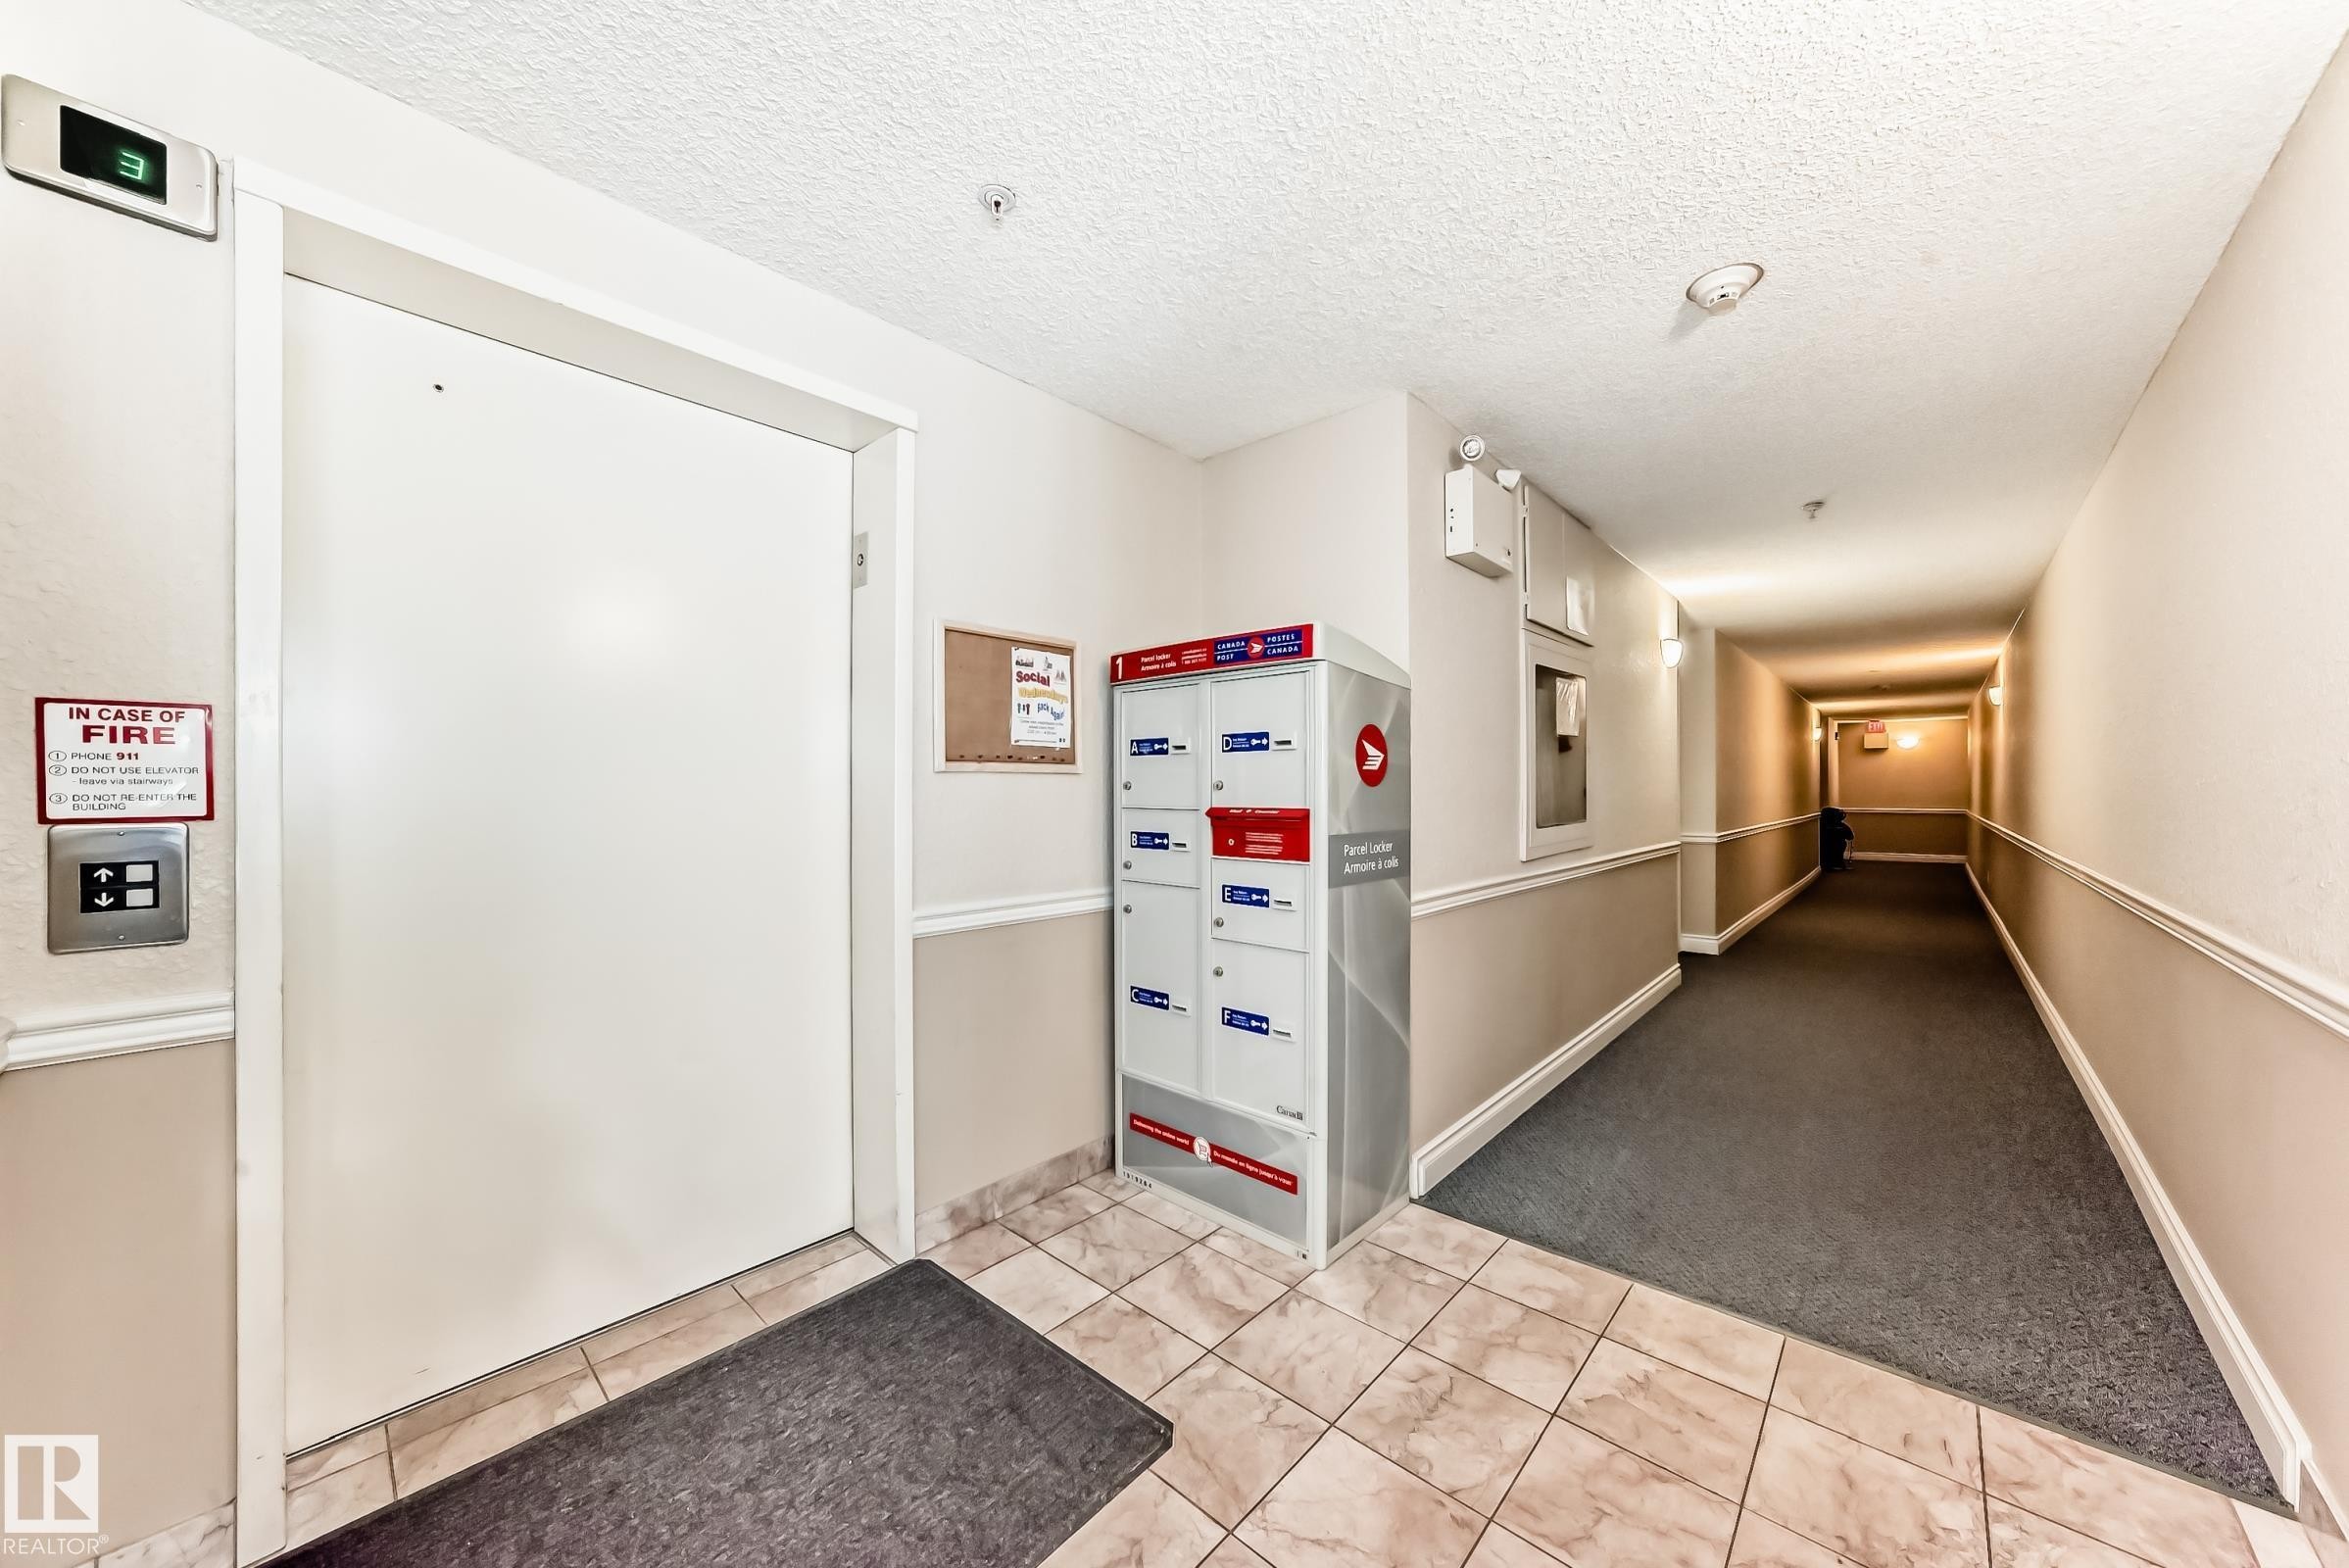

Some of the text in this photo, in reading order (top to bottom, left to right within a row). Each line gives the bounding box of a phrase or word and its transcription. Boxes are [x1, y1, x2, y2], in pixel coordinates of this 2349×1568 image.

[120, 150, 144, 180] 3
[1216, 640, 1246, 650] CANADA
[1266, 633, 1296, 643] POSTES
[1266, 645, 1298, 656] CANADA
[1115, 657, 1123, 680] 1
[1015, 670, 1051, 687] Social
[69, 707, 185, 723] IN CASE OF
[81, 724, 176, 745] FIRE
[1131, 742, 1139, 755] A
[1223, 736, 1232, 751] D
[71, 752, 113, 760] PHONE
[116, 752, 139, 760] 911
[127, 777, 173, 786] stairways
[73, 802, 126, 811] BUILDING
[1131, 833, 1138, 847] B
[1344, 840, 1394, 857] Parcel Locker
[1344, 856, 1399, 875] Armoire à colis
[1224, 887, 1232, 902] E
[1131, 989, 1139, 1003] C
[1224, 1009, 1231, 1024] F
